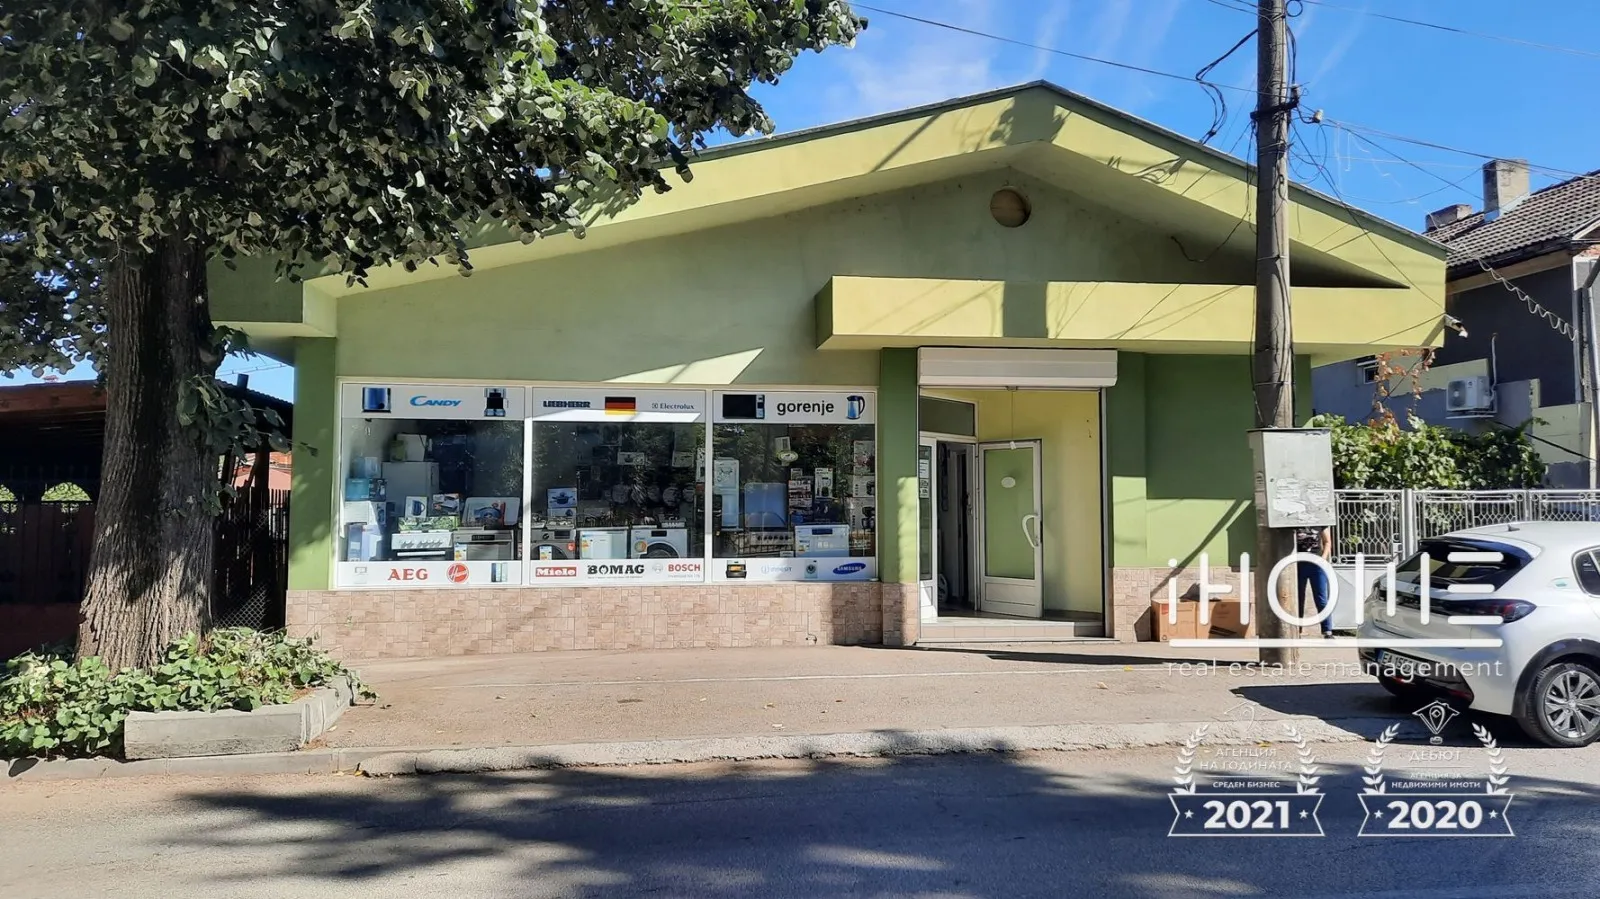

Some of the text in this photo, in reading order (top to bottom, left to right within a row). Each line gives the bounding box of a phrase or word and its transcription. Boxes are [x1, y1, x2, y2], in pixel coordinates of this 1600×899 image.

[410, 395, 462, 407] CANDY
[543, 400, 591, 408] LIEBHERR
[659, 402, 695, 410] Electrolux
[776, 399, 835, 416] gorenje
[537, 568, 575, 576] Miele
[587, 564, 645, 575] BOMAG
[668, 564, 701, 572] BOSCH
[387, 568, 428, 581] AEG
